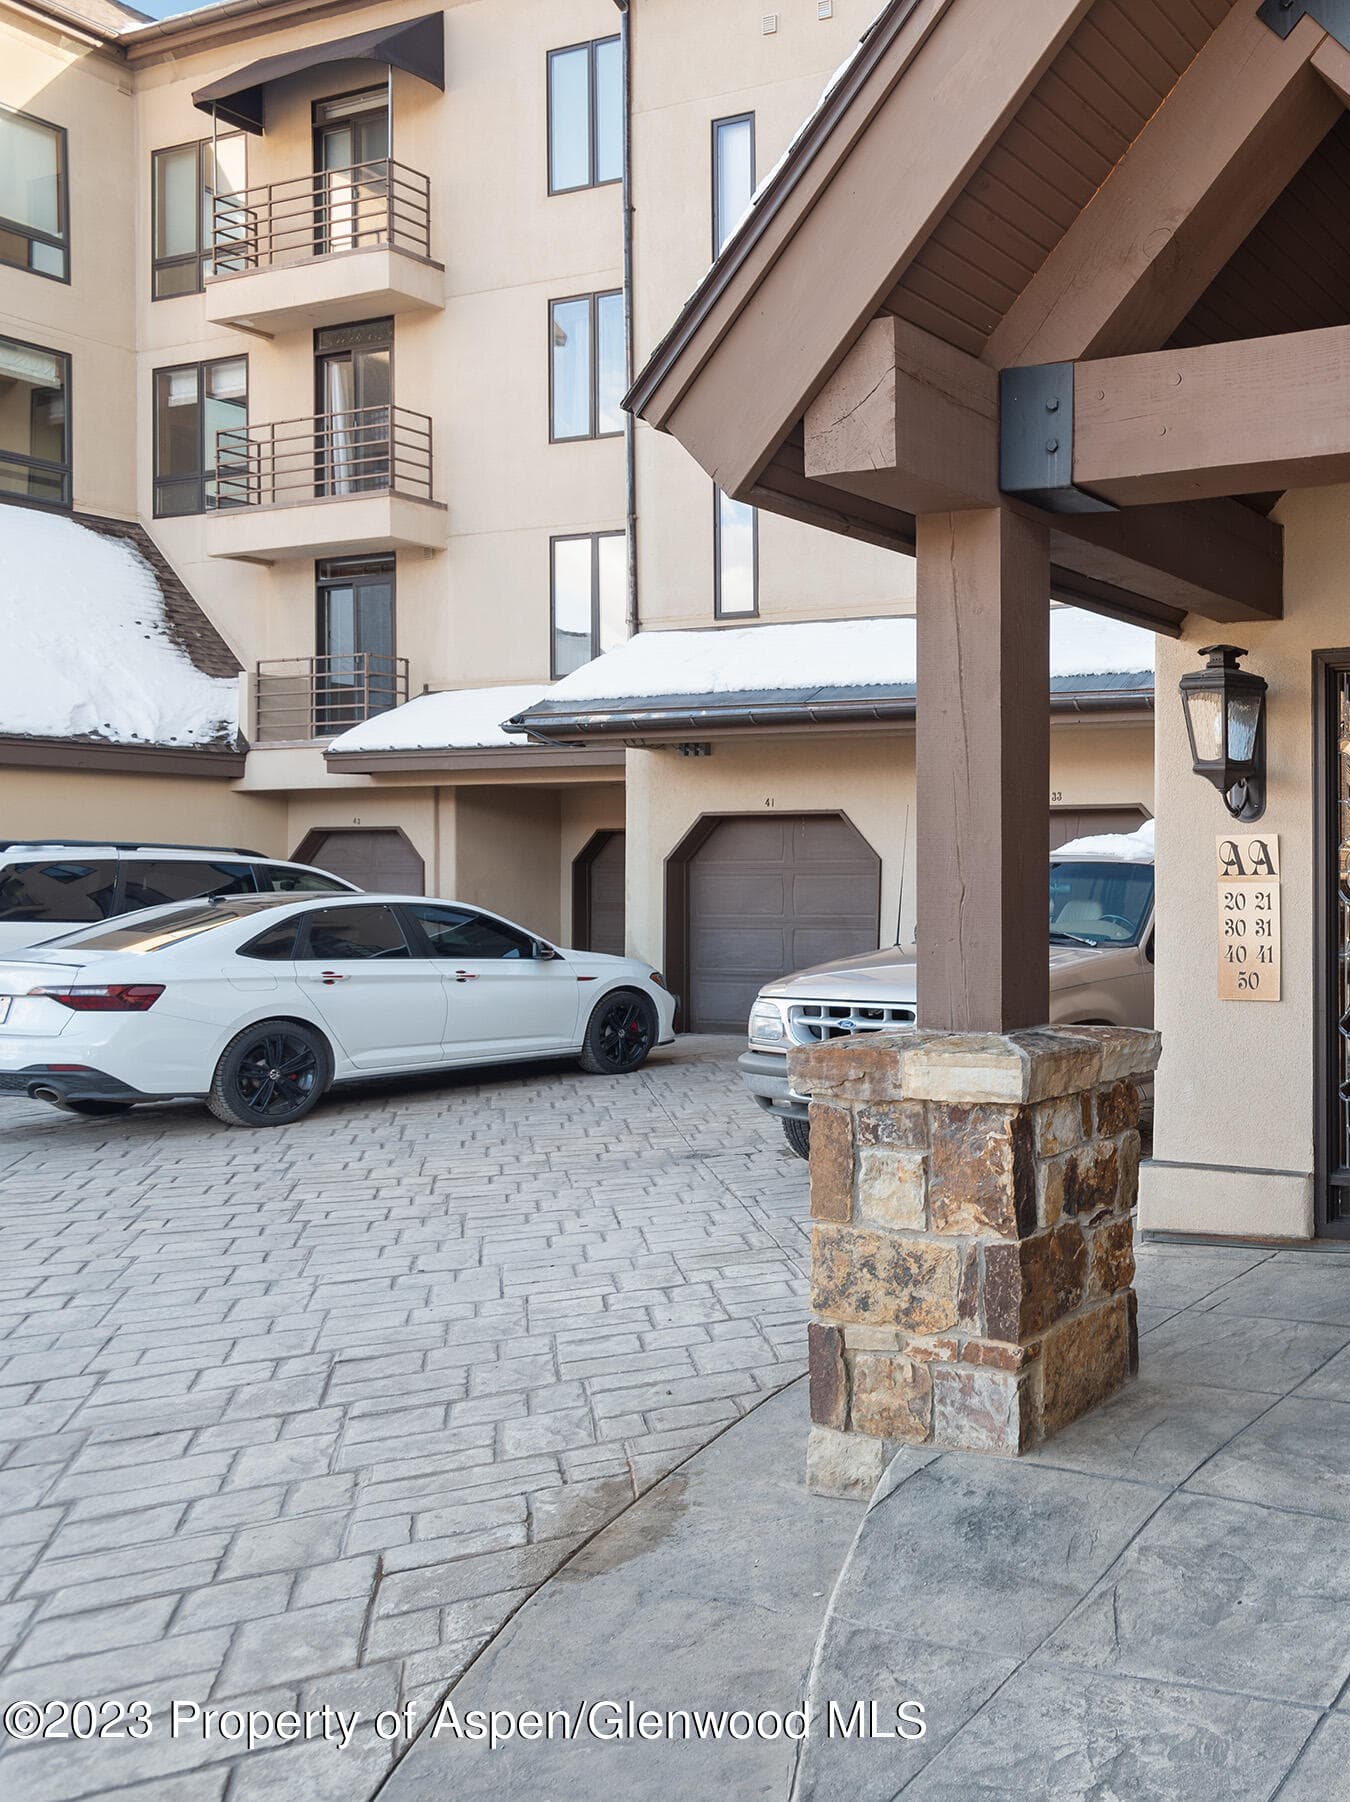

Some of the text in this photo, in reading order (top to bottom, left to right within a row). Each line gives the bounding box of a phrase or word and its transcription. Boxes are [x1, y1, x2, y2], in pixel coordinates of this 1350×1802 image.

[764, 798, 775, 807] 41
[1224, 892, 1272, 911] 20 21
[1224, 918, 1272, 937] 30 31
[1224, 944, 1273, 964] 40 41
[1238, 971, 1260, 990] 50
